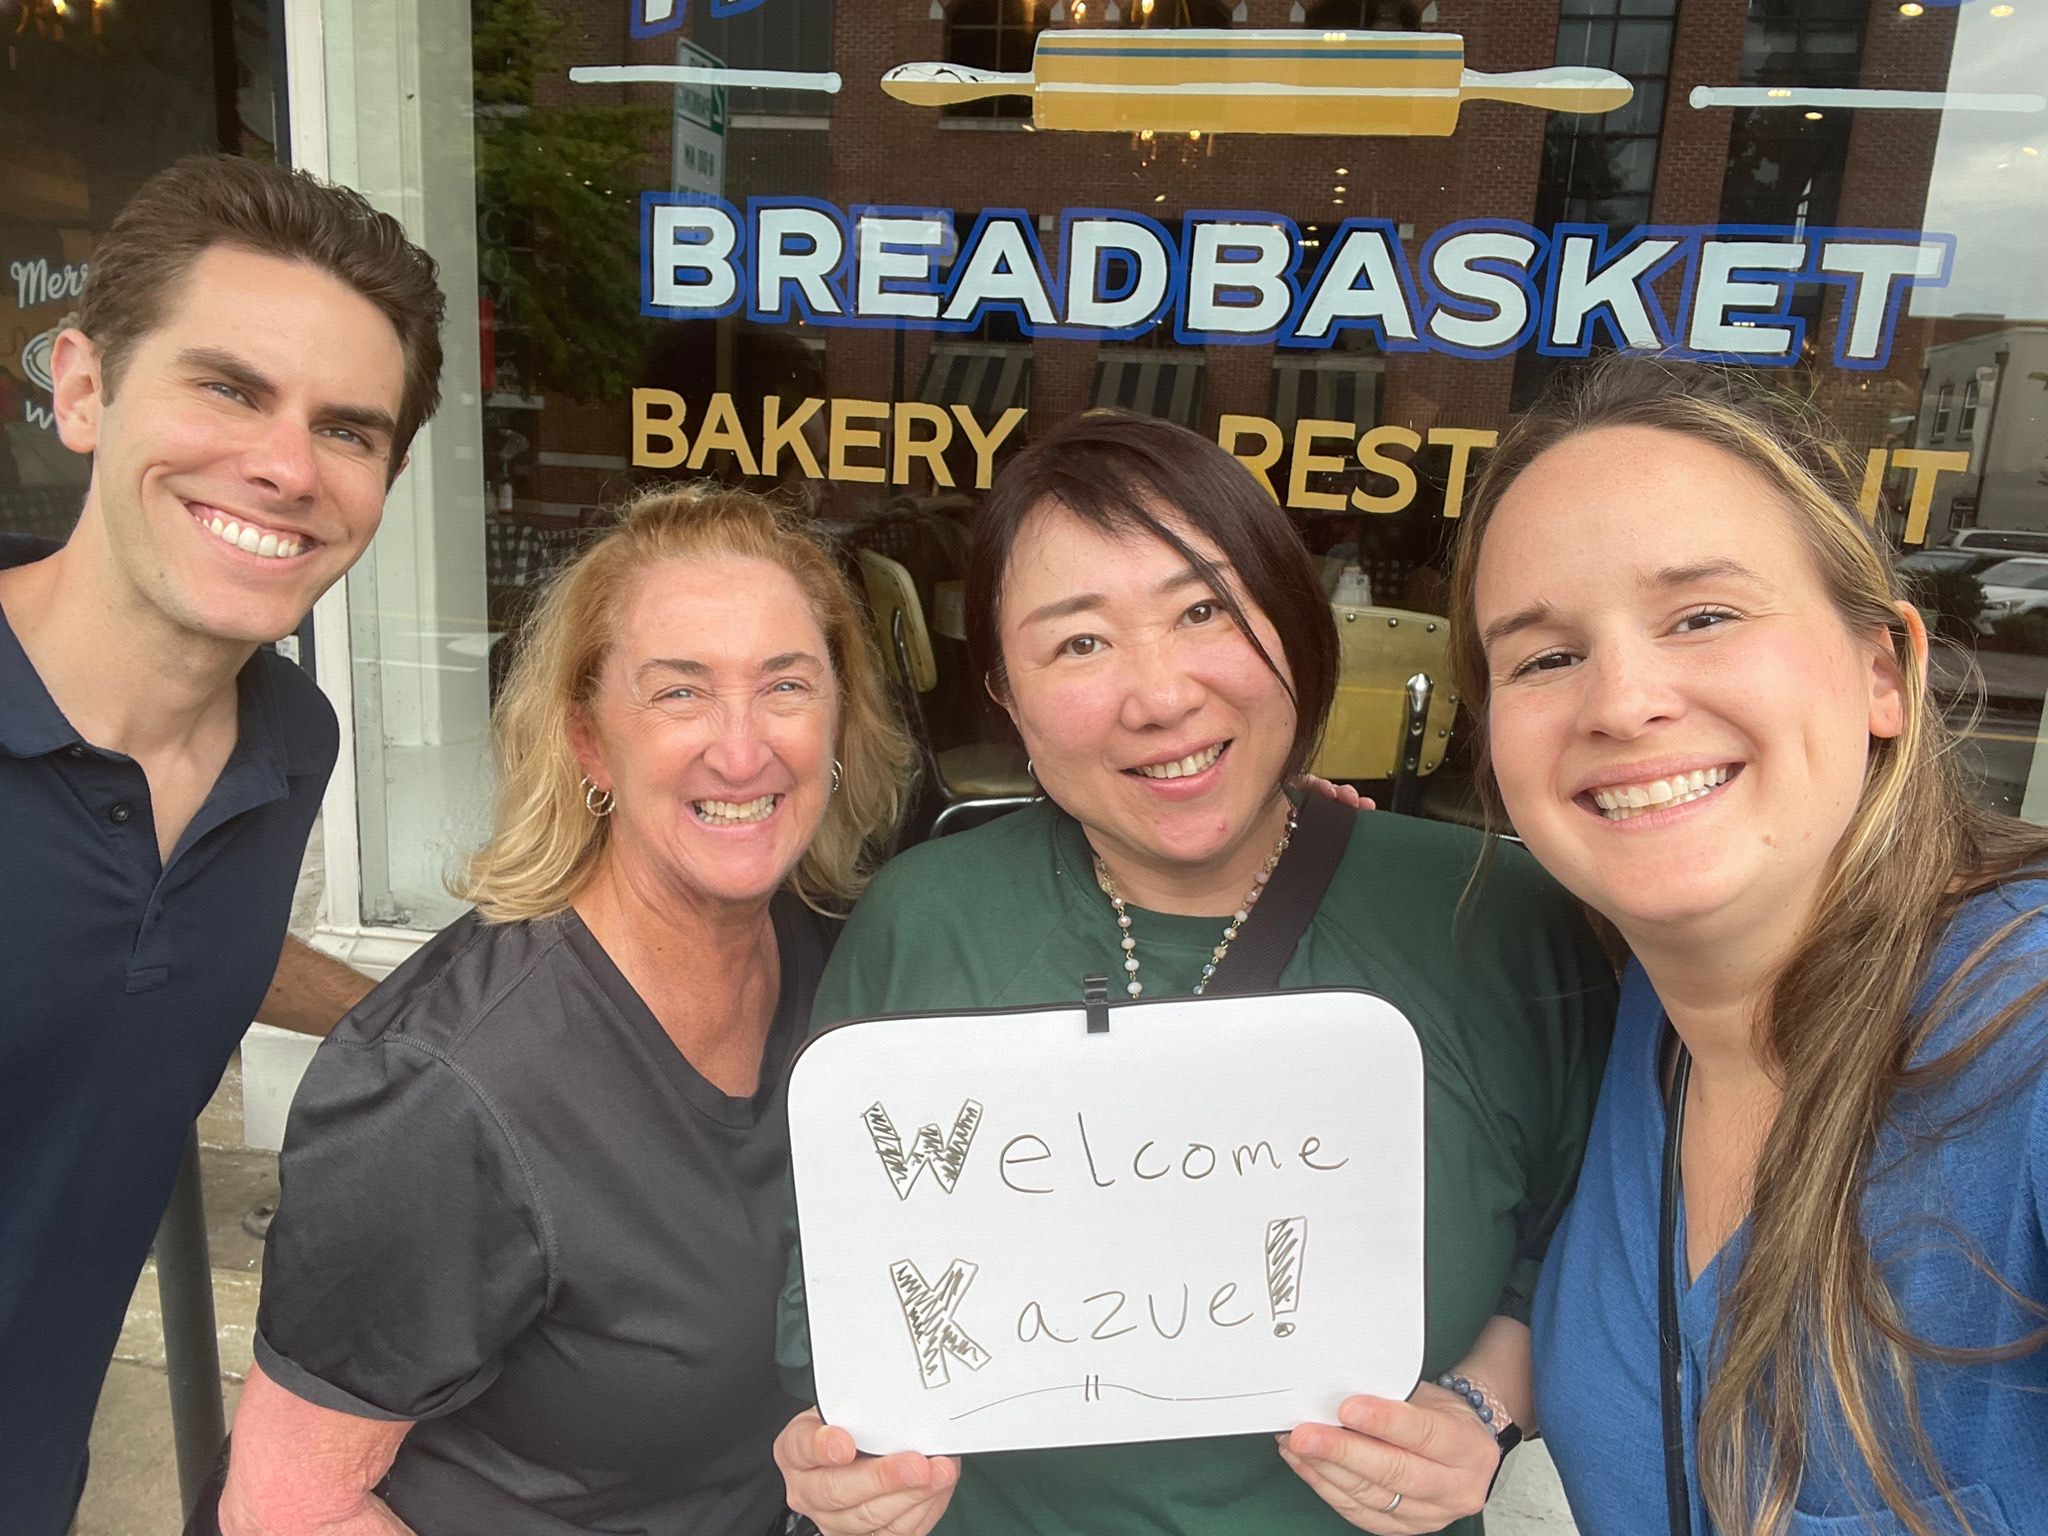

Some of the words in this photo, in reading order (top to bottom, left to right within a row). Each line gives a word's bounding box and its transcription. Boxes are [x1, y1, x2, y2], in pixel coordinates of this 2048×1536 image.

[641, 192, 1956, 370] BREADBASKET
[632, 387, 1028, 490] BAKERY
[860, 1098, 1349, 1201] Welcome
[889, 1216, 1308, 1390] Kazue!
